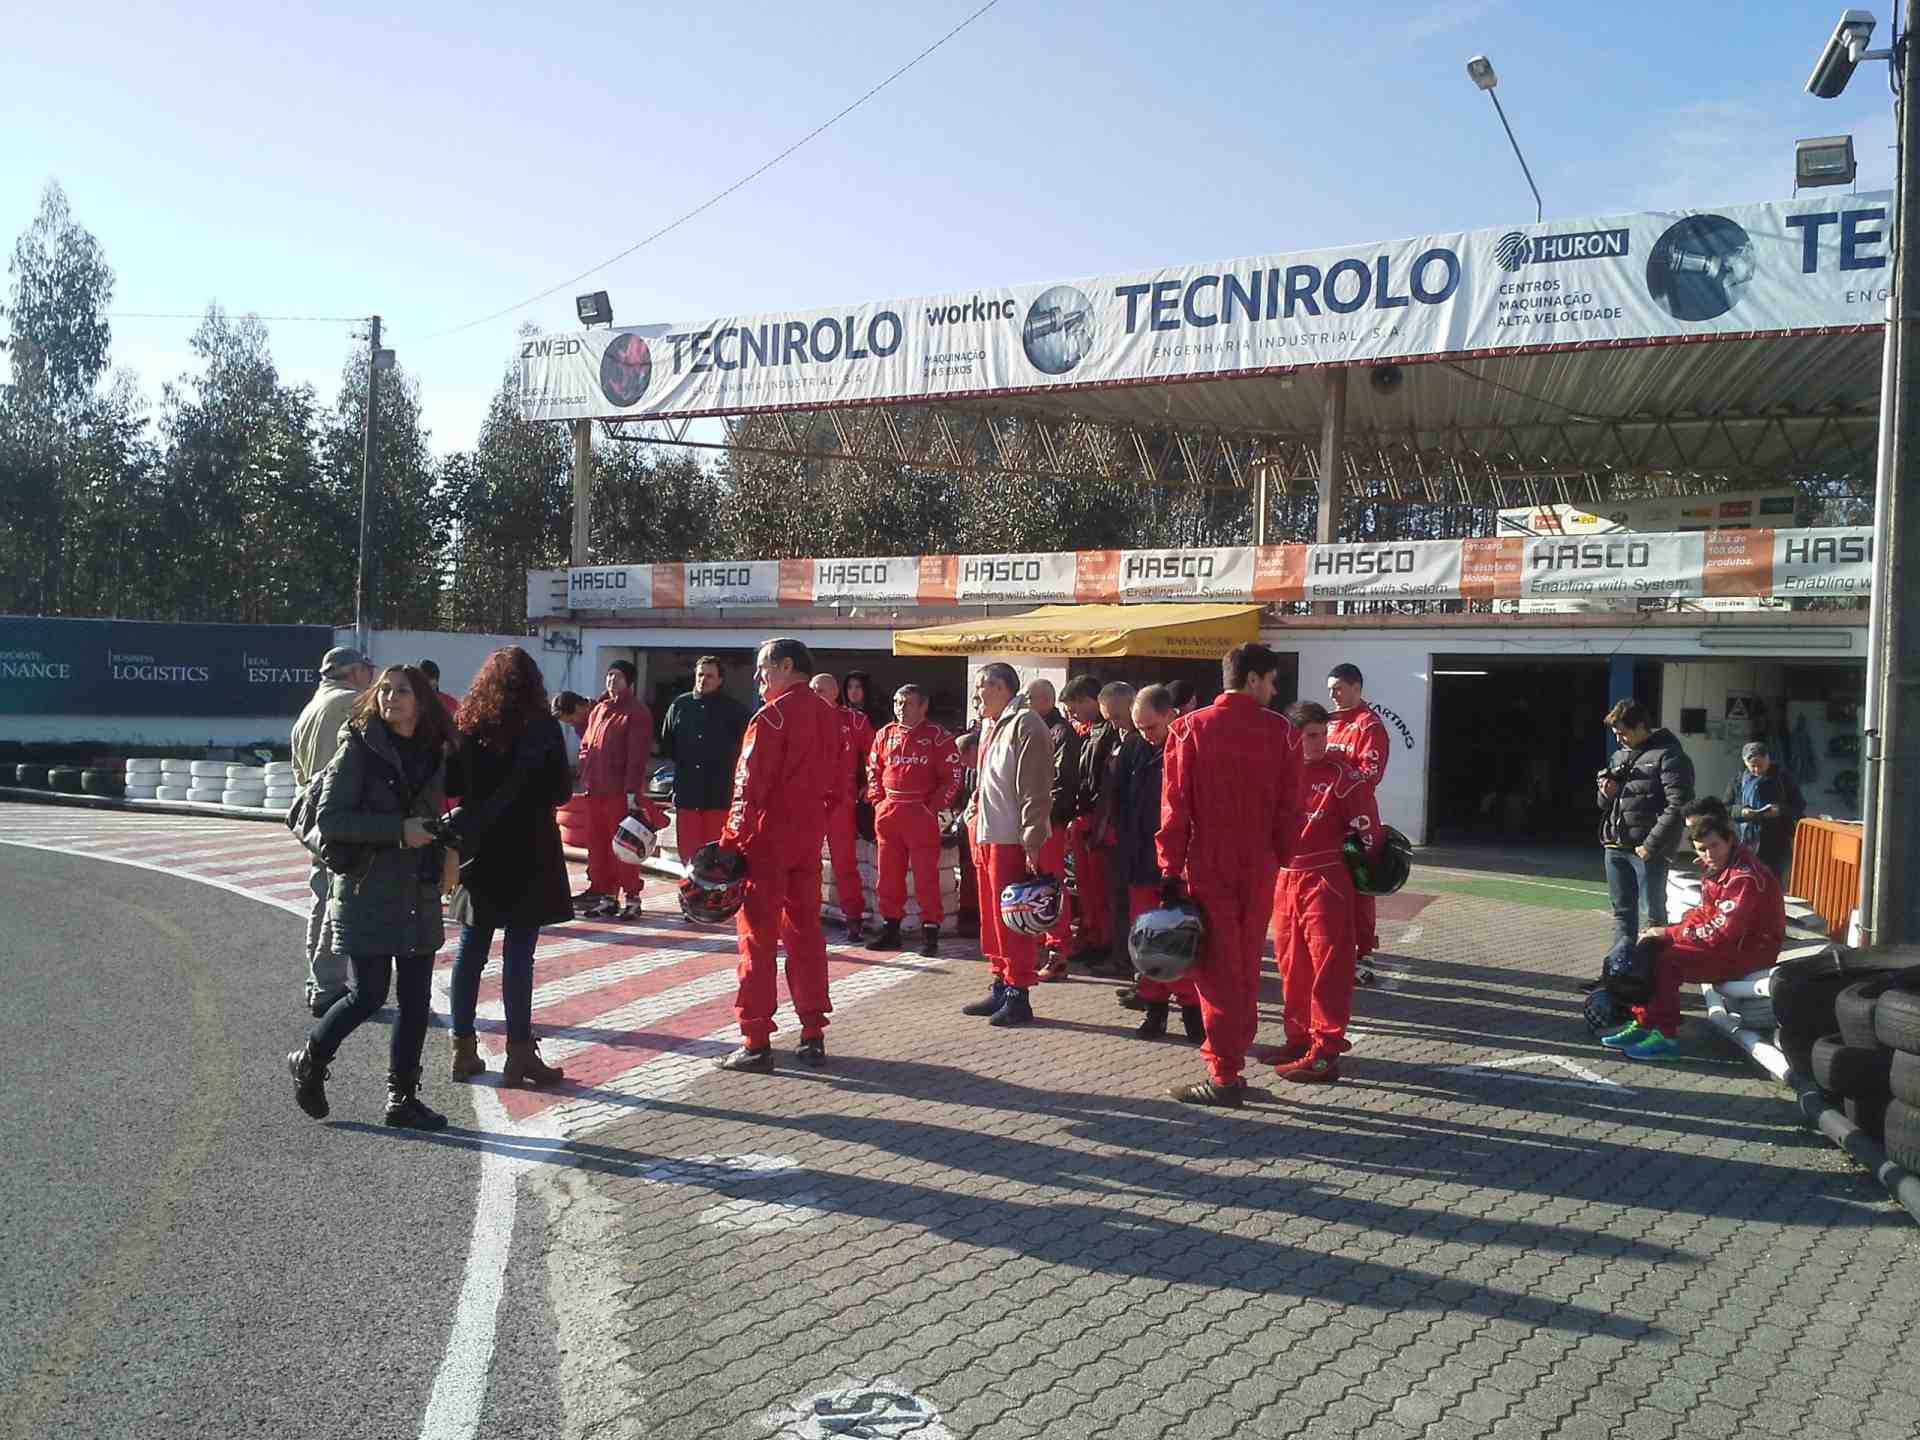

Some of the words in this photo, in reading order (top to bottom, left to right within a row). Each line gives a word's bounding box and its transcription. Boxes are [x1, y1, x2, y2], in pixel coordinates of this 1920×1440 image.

[1541, 233, 1621, 260] HURON
[1115, 248, 1461, 335] TECNIROLO
[1499, 280, 1561, 295] CENTROS
[926, 295, 1015, 327] worknc
[1498, 290, 1592, 312] MAQUINAÇÃO
[1497, 316, 1531, 328] ALTA
[1534, 307, 1623, 324] VELOCIDADE
[665, 311, 903, 375] TECNIROLO
[1153, 340, 1250, 359] ENGENHARIA
[946, 365, 972, 376] EIXOS
[1533, 543, 1649, 569] HASCO
[1784, 536, 1873, 564] HAS
[964, 561, 1040, 582] HASCO
[1127, 556, 1214, 579] HASCO
[1314, 550, 1415, 575] HASCO
[571, 571, 627, 590] HASCO
[689, 568, 750, 587] HASCO
[819, 565, 887, 585] HASCO
[1784, 575, 1855, 591] Enabling
[1531, 578, 1594, 595] Enabling
[1599, 577, 1627, 592] with
[112, 665, 209, 681] LOGISTICS
[248, 668, 315, 683] ESTATE
